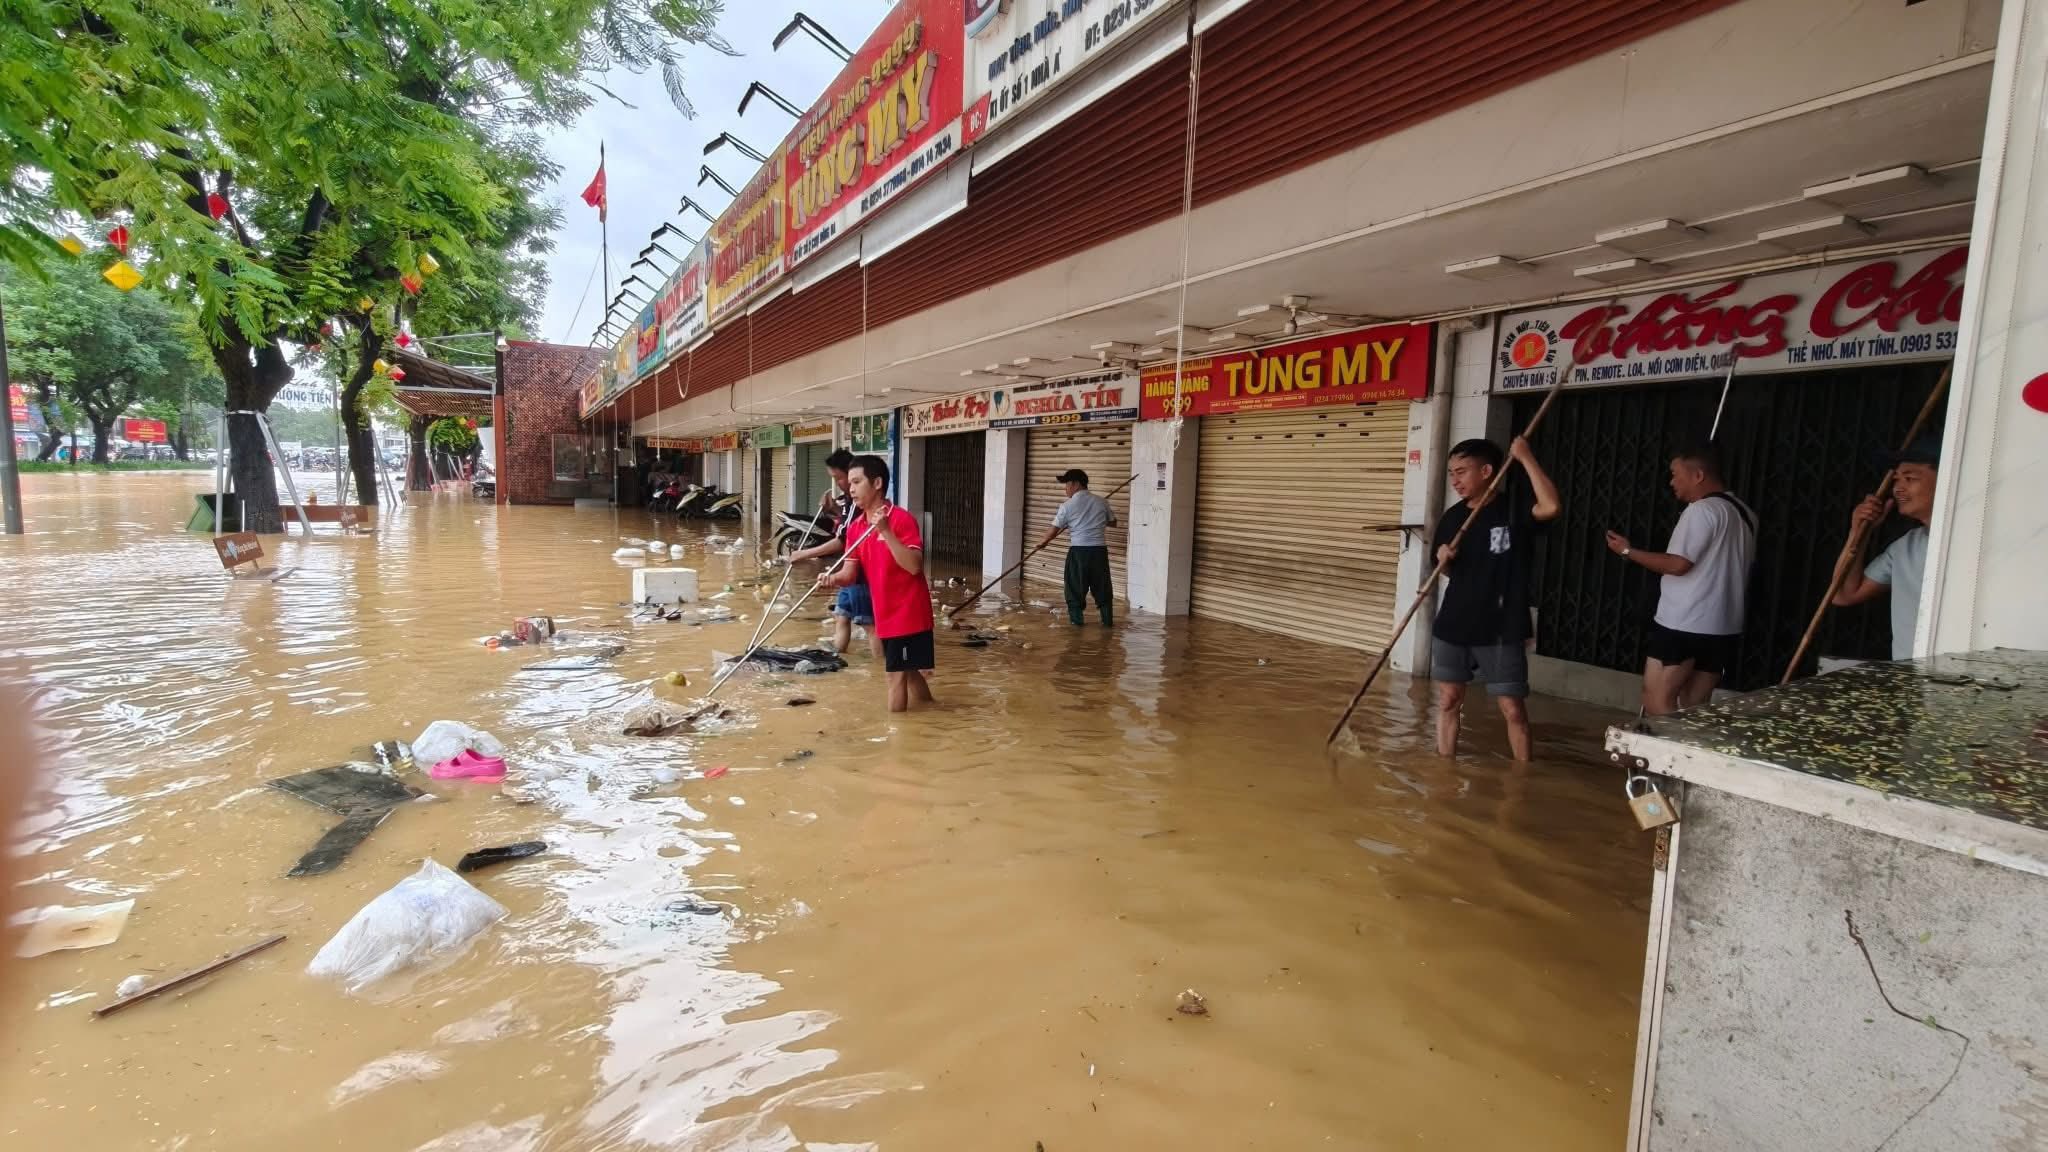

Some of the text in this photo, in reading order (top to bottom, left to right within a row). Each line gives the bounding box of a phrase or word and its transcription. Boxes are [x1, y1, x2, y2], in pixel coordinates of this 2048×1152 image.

[867, 50, 935, 166] MY
[1840, 336, 1866, 359] MÁY
[1900, 333, 1932, 354] 0903
[1223, 338, 1405, 397] TÙNG MY
[1503, 371, 1529, 390] CHUYÊN
[1015, 390, 1077, 416] NGHĨA
[1080, 384, 1123, 409] TÍN
[1041, 413, 1081, 425] 9999
